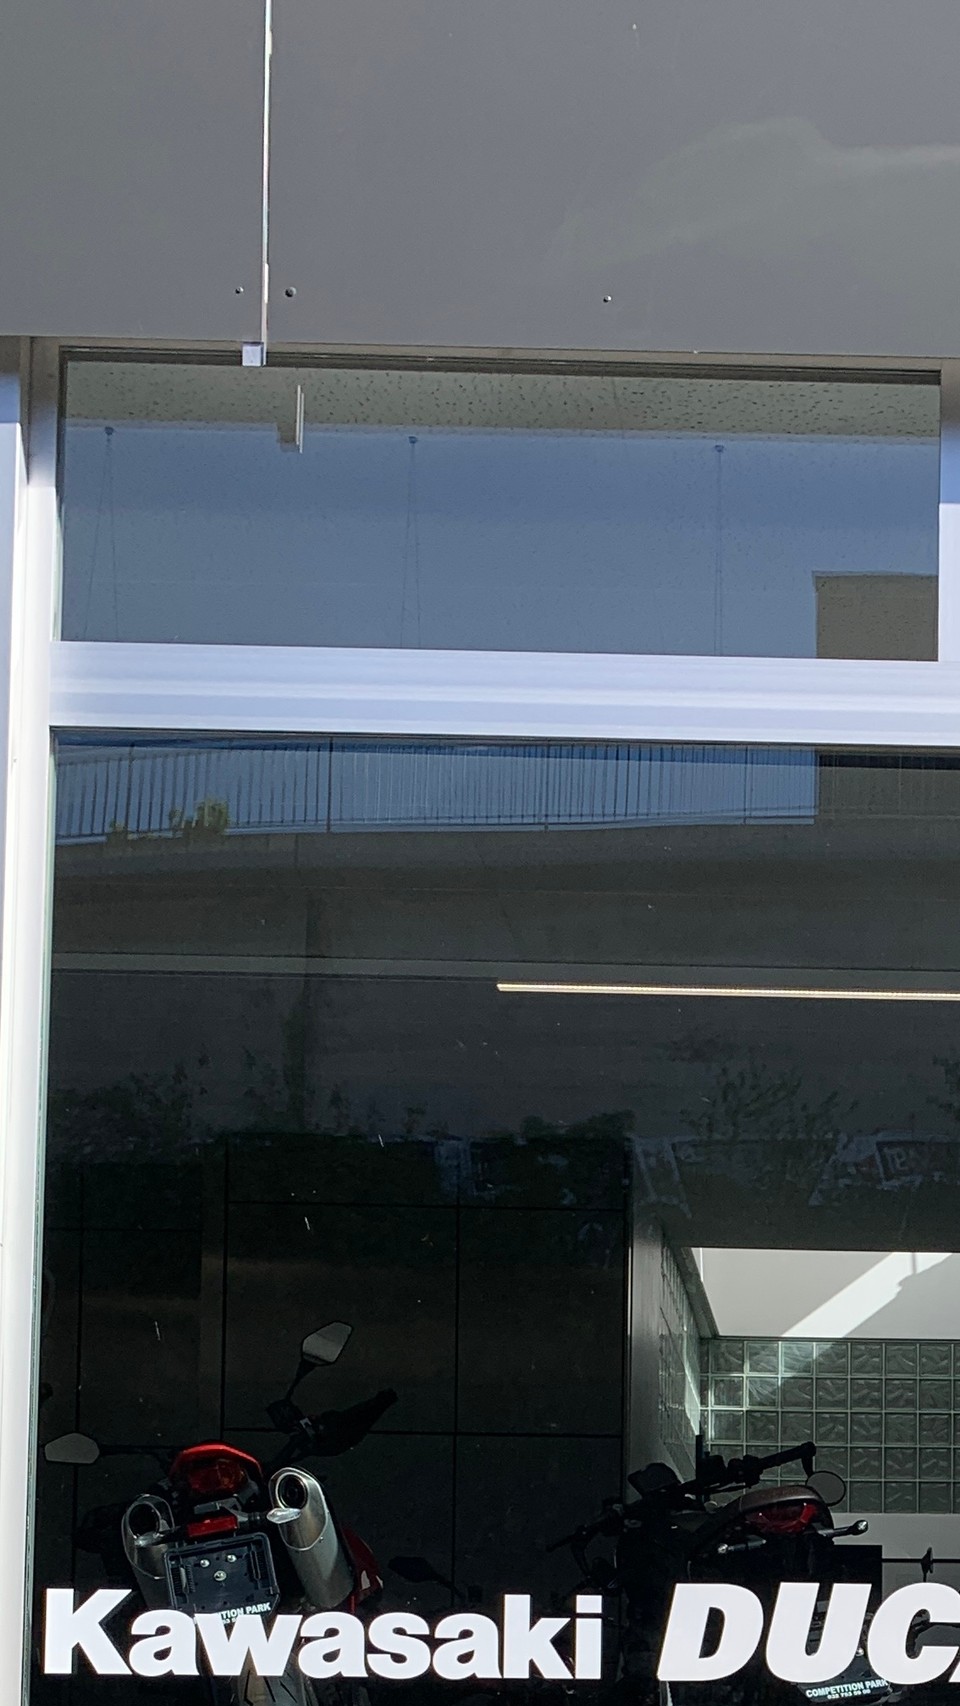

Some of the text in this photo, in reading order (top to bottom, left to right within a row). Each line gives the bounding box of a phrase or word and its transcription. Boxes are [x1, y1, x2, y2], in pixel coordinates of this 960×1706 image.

[43, 1588, 603, 1680] Kawasaki
[805, 1679, 888, 1698] COMPETITION PARK
